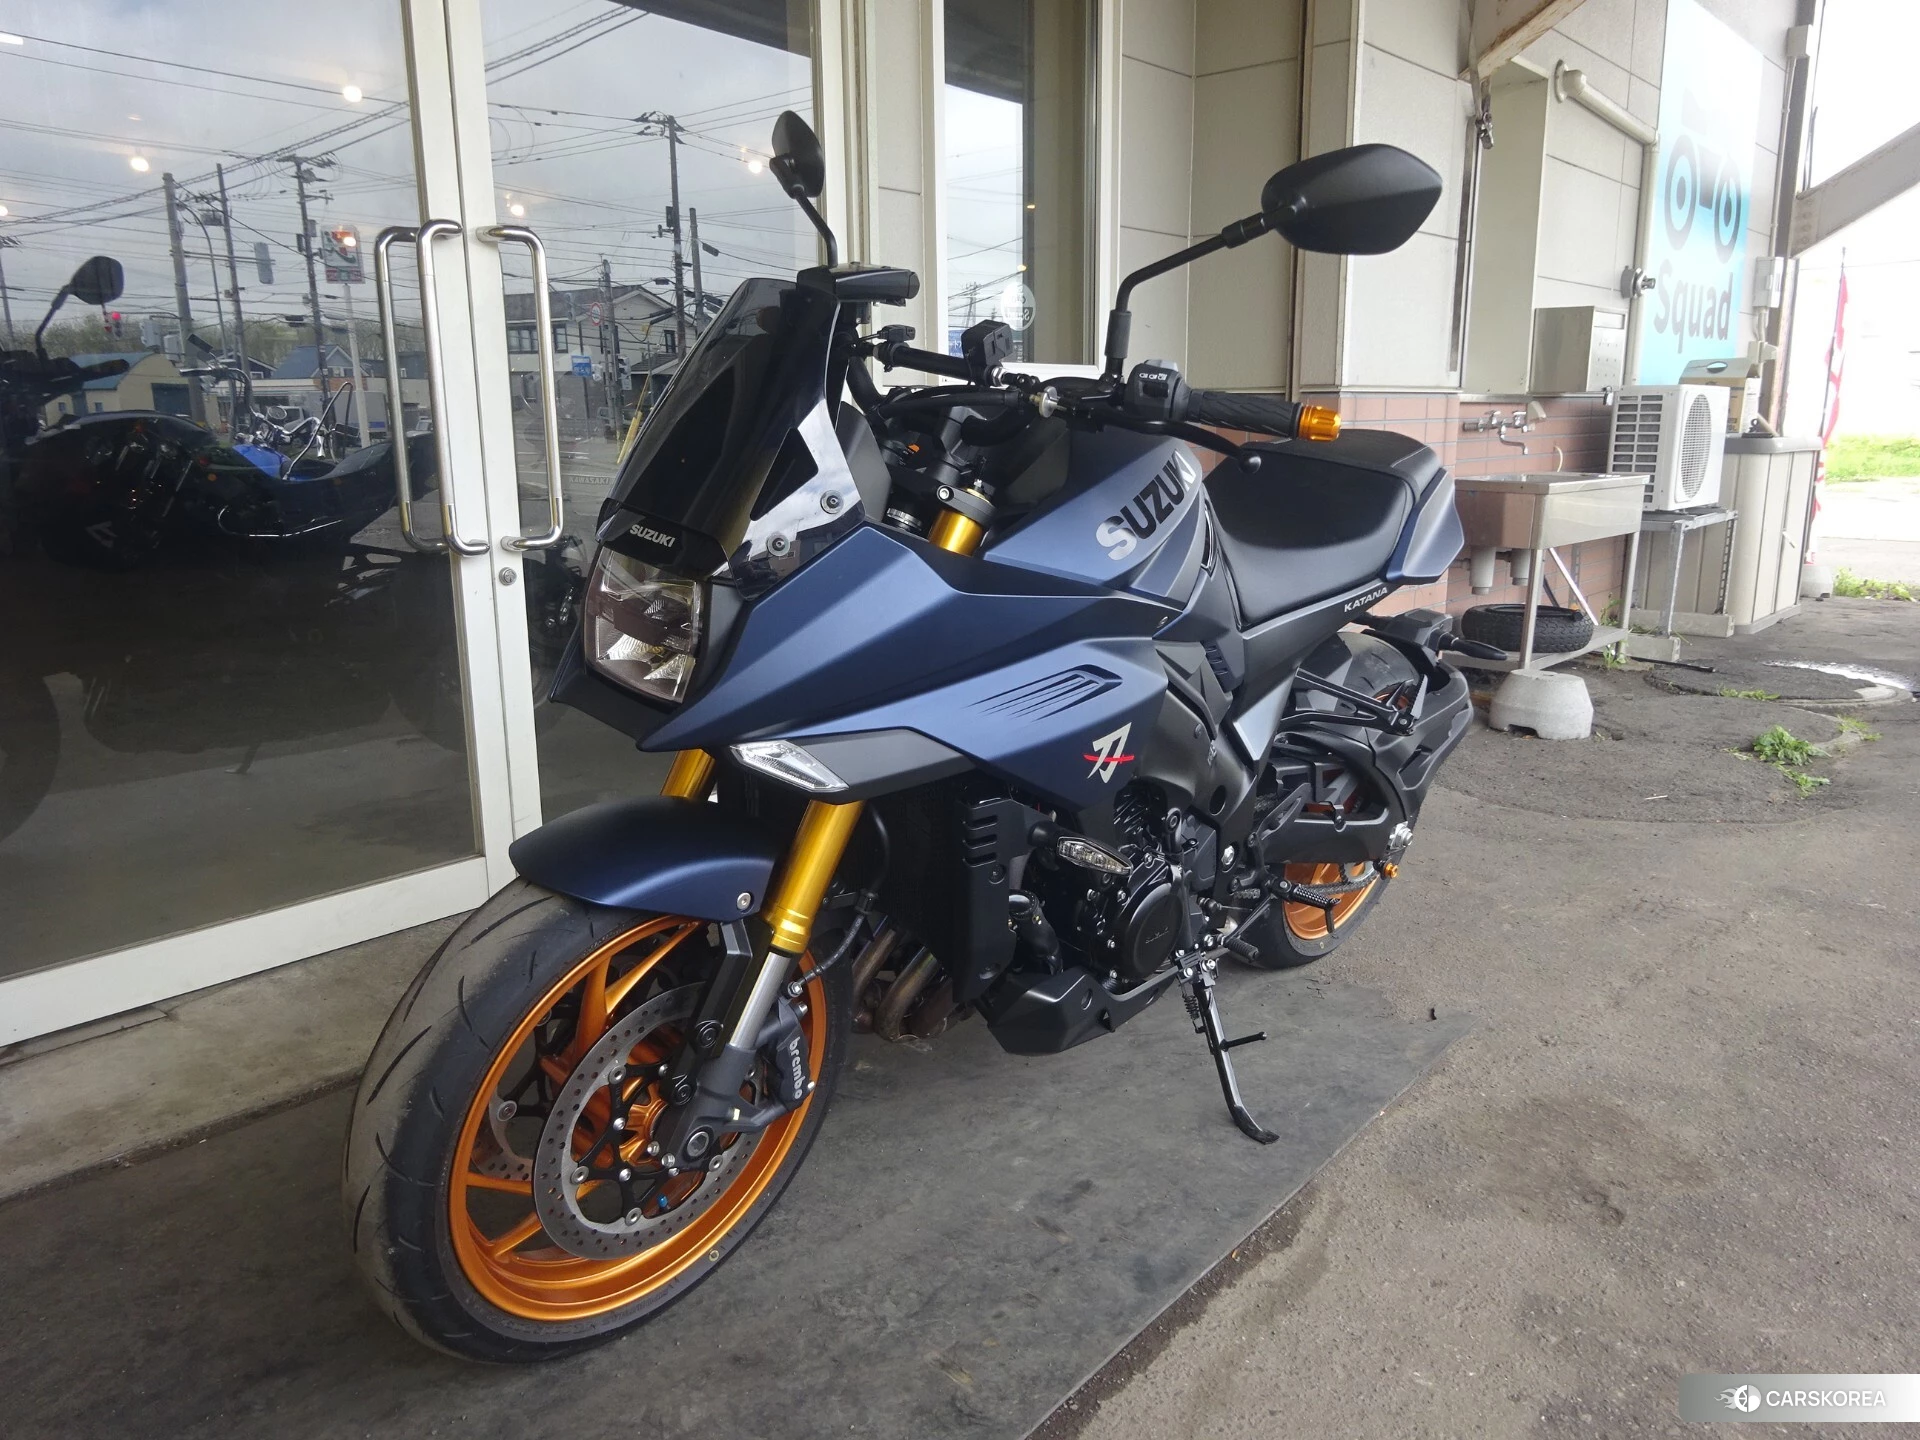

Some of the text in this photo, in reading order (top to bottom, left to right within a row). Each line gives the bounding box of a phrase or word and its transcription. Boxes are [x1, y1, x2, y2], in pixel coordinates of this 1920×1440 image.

[1653, 258, 1734, 354] Squad
[629, 523, 677, 548] SUZUKI
[1095, 448, 1197, 561] SUZUKI
[1344, 587, 1388, 612] KATANA
[789, 1036, 803, 1100] brembo
